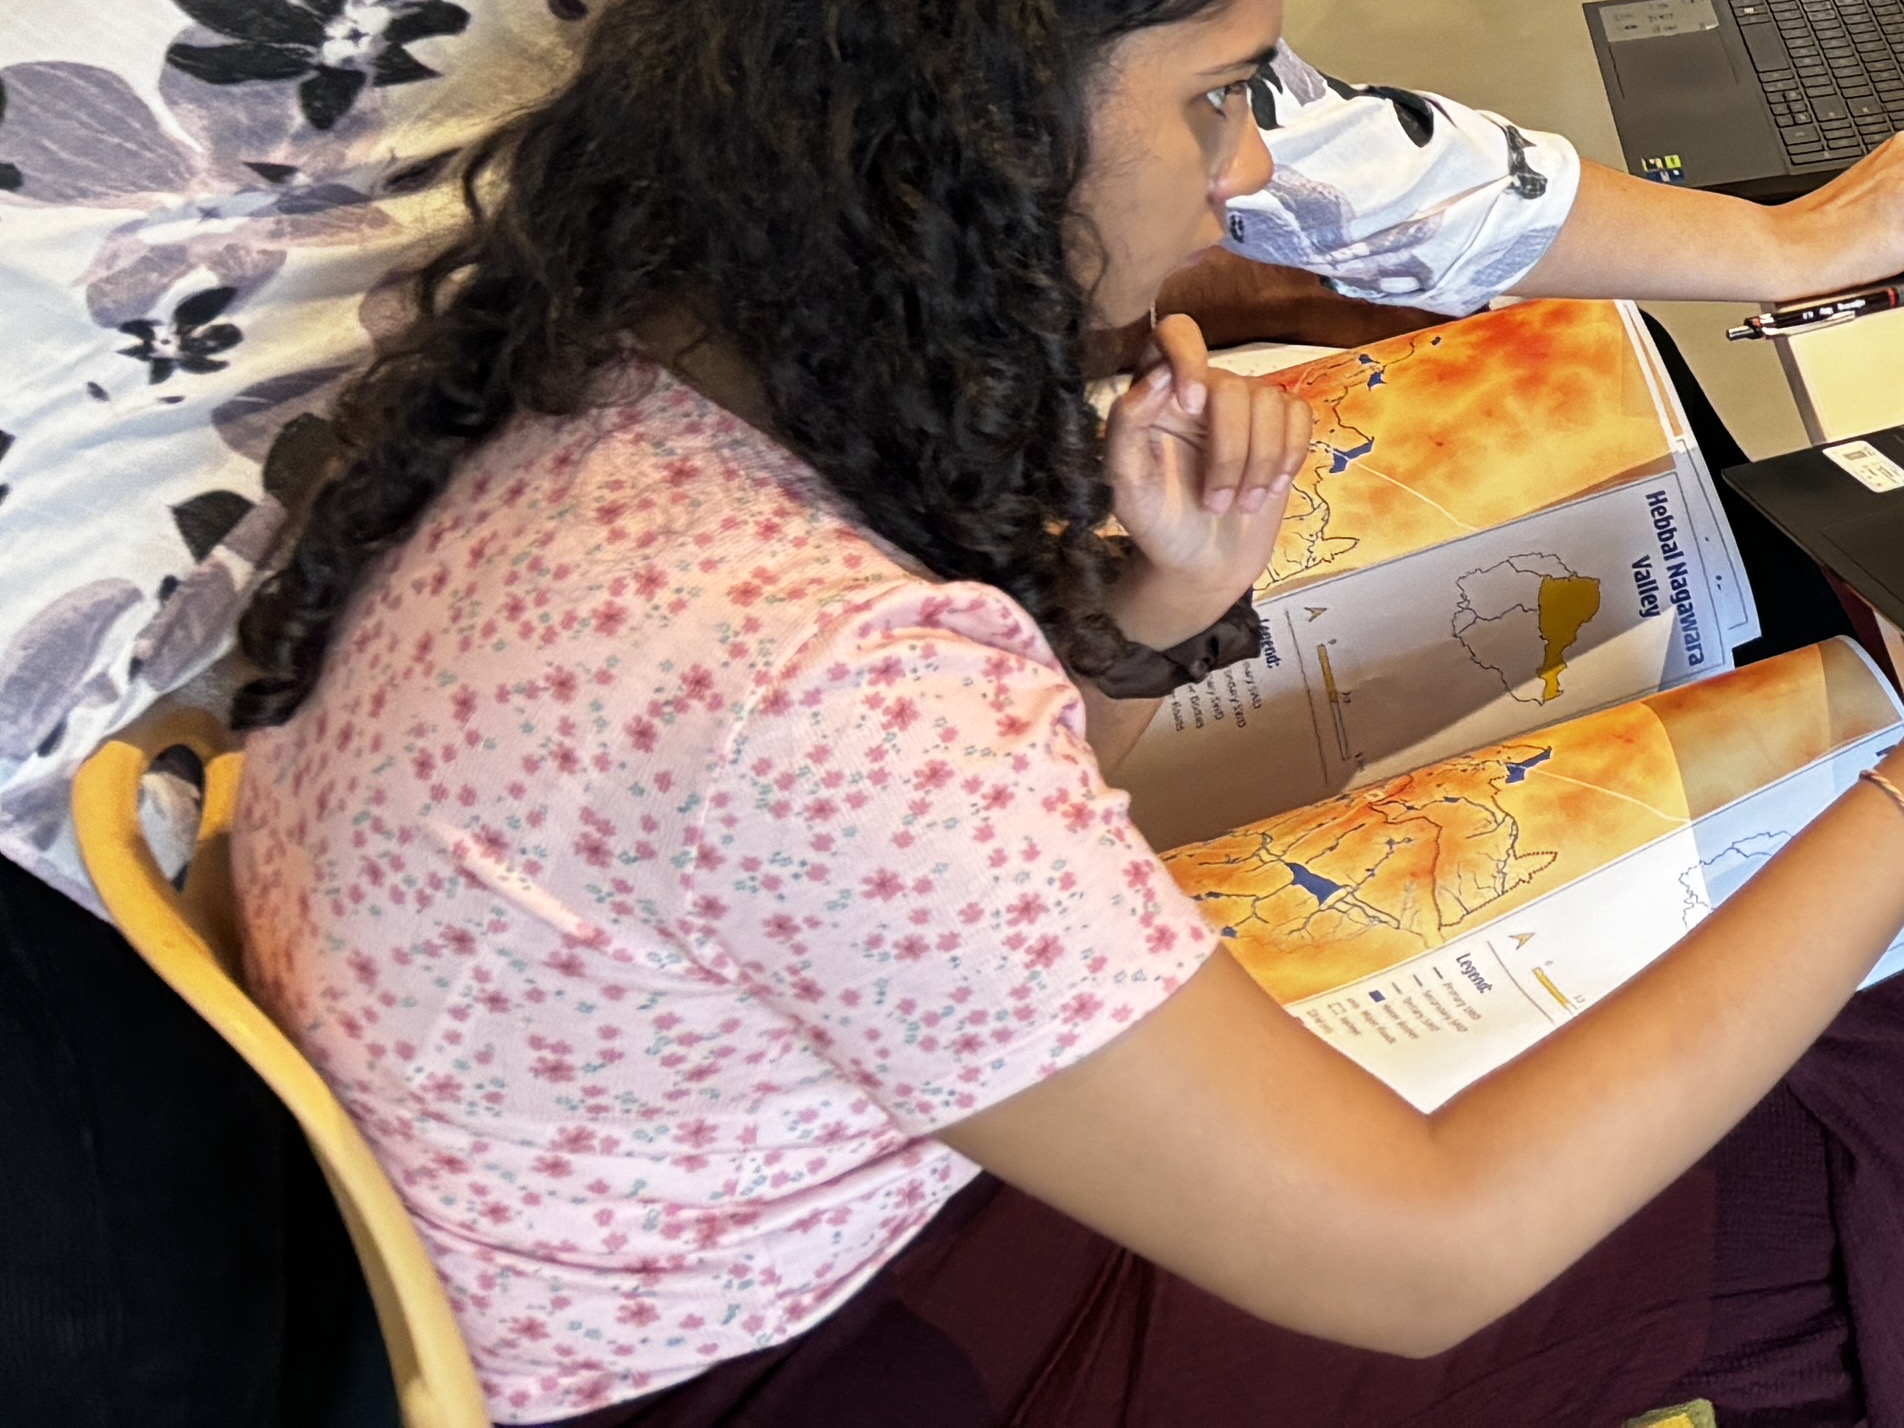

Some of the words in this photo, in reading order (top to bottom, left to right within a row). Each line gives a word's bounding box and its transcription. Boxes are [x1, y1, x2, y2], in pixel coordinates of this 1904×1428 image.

[1631, 554, 1661, 619] Valley
[1645, 490, 1685, 561] Hebbal
[1666, 561, 1705, 667] Nagawara
